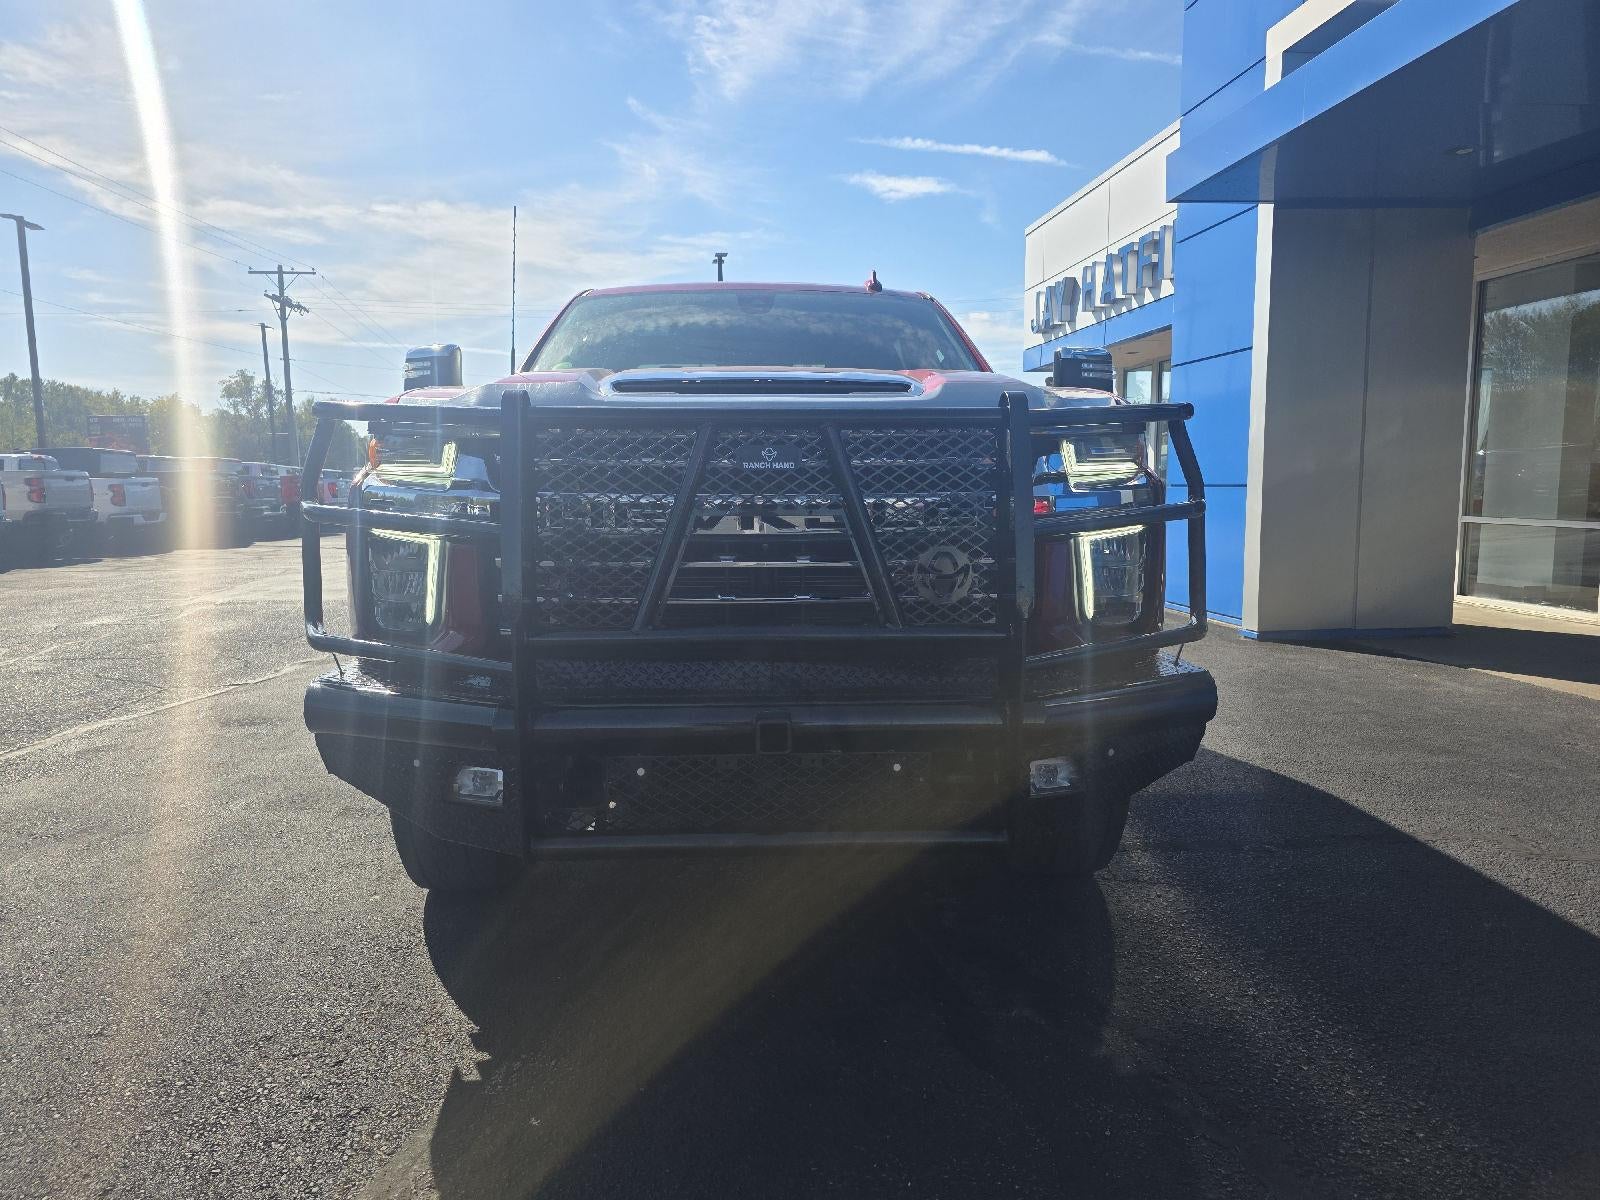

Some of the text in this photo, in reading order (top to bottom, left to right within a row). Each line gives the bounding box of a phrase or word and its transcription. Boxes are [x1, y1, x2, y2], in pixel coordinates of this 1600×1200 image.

[1030, 219, 1176, 334] JAY HATFI
[742, 461, 795, 469] RANCH HAND
